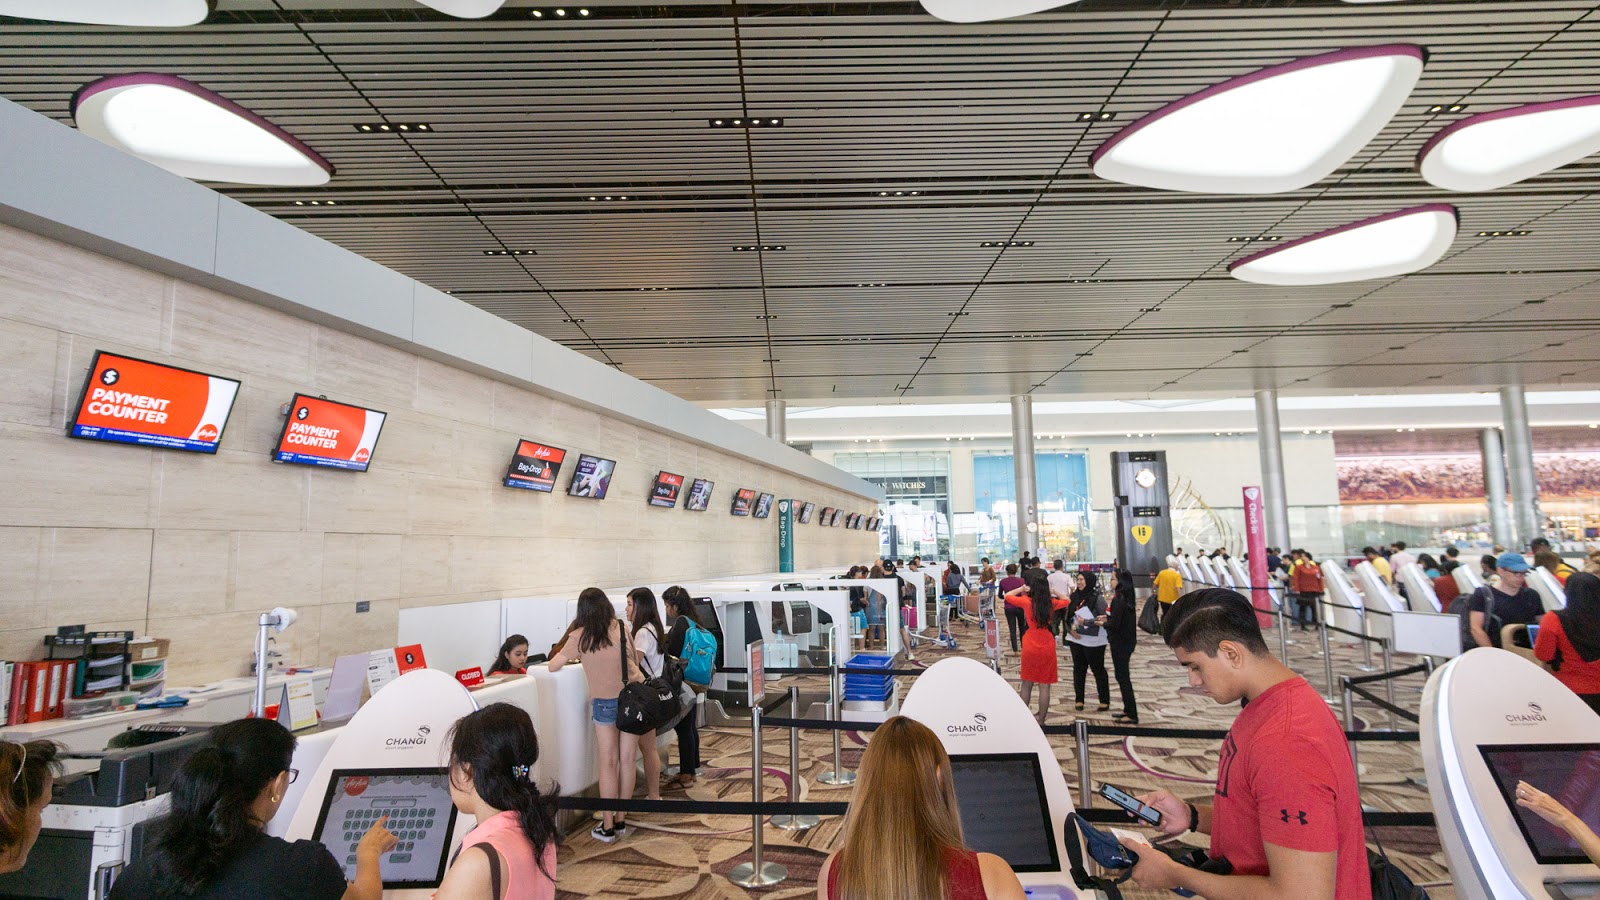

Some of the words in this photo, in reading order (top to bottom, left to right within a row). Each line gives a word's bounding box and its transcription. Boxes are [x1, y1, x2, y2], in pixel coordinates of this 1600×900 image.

[92, 388, 170, 410] PAYMENT
[88, 402, 168, 424] COUNTER
[290, 423, 340, 439] PAYMENT
[287, 433, 337, 449] COUNTER
[517, 462, 542, 475] Bag-Drop
[1248, 502, 1258, 535] Check-in
[461, 671, 480, 681] CLOSED
[1505, 714, 1547, 722] CHANGI
[947, 725, 987, 733] CHANGI
[385, 737, 427, 746] CHANGI
